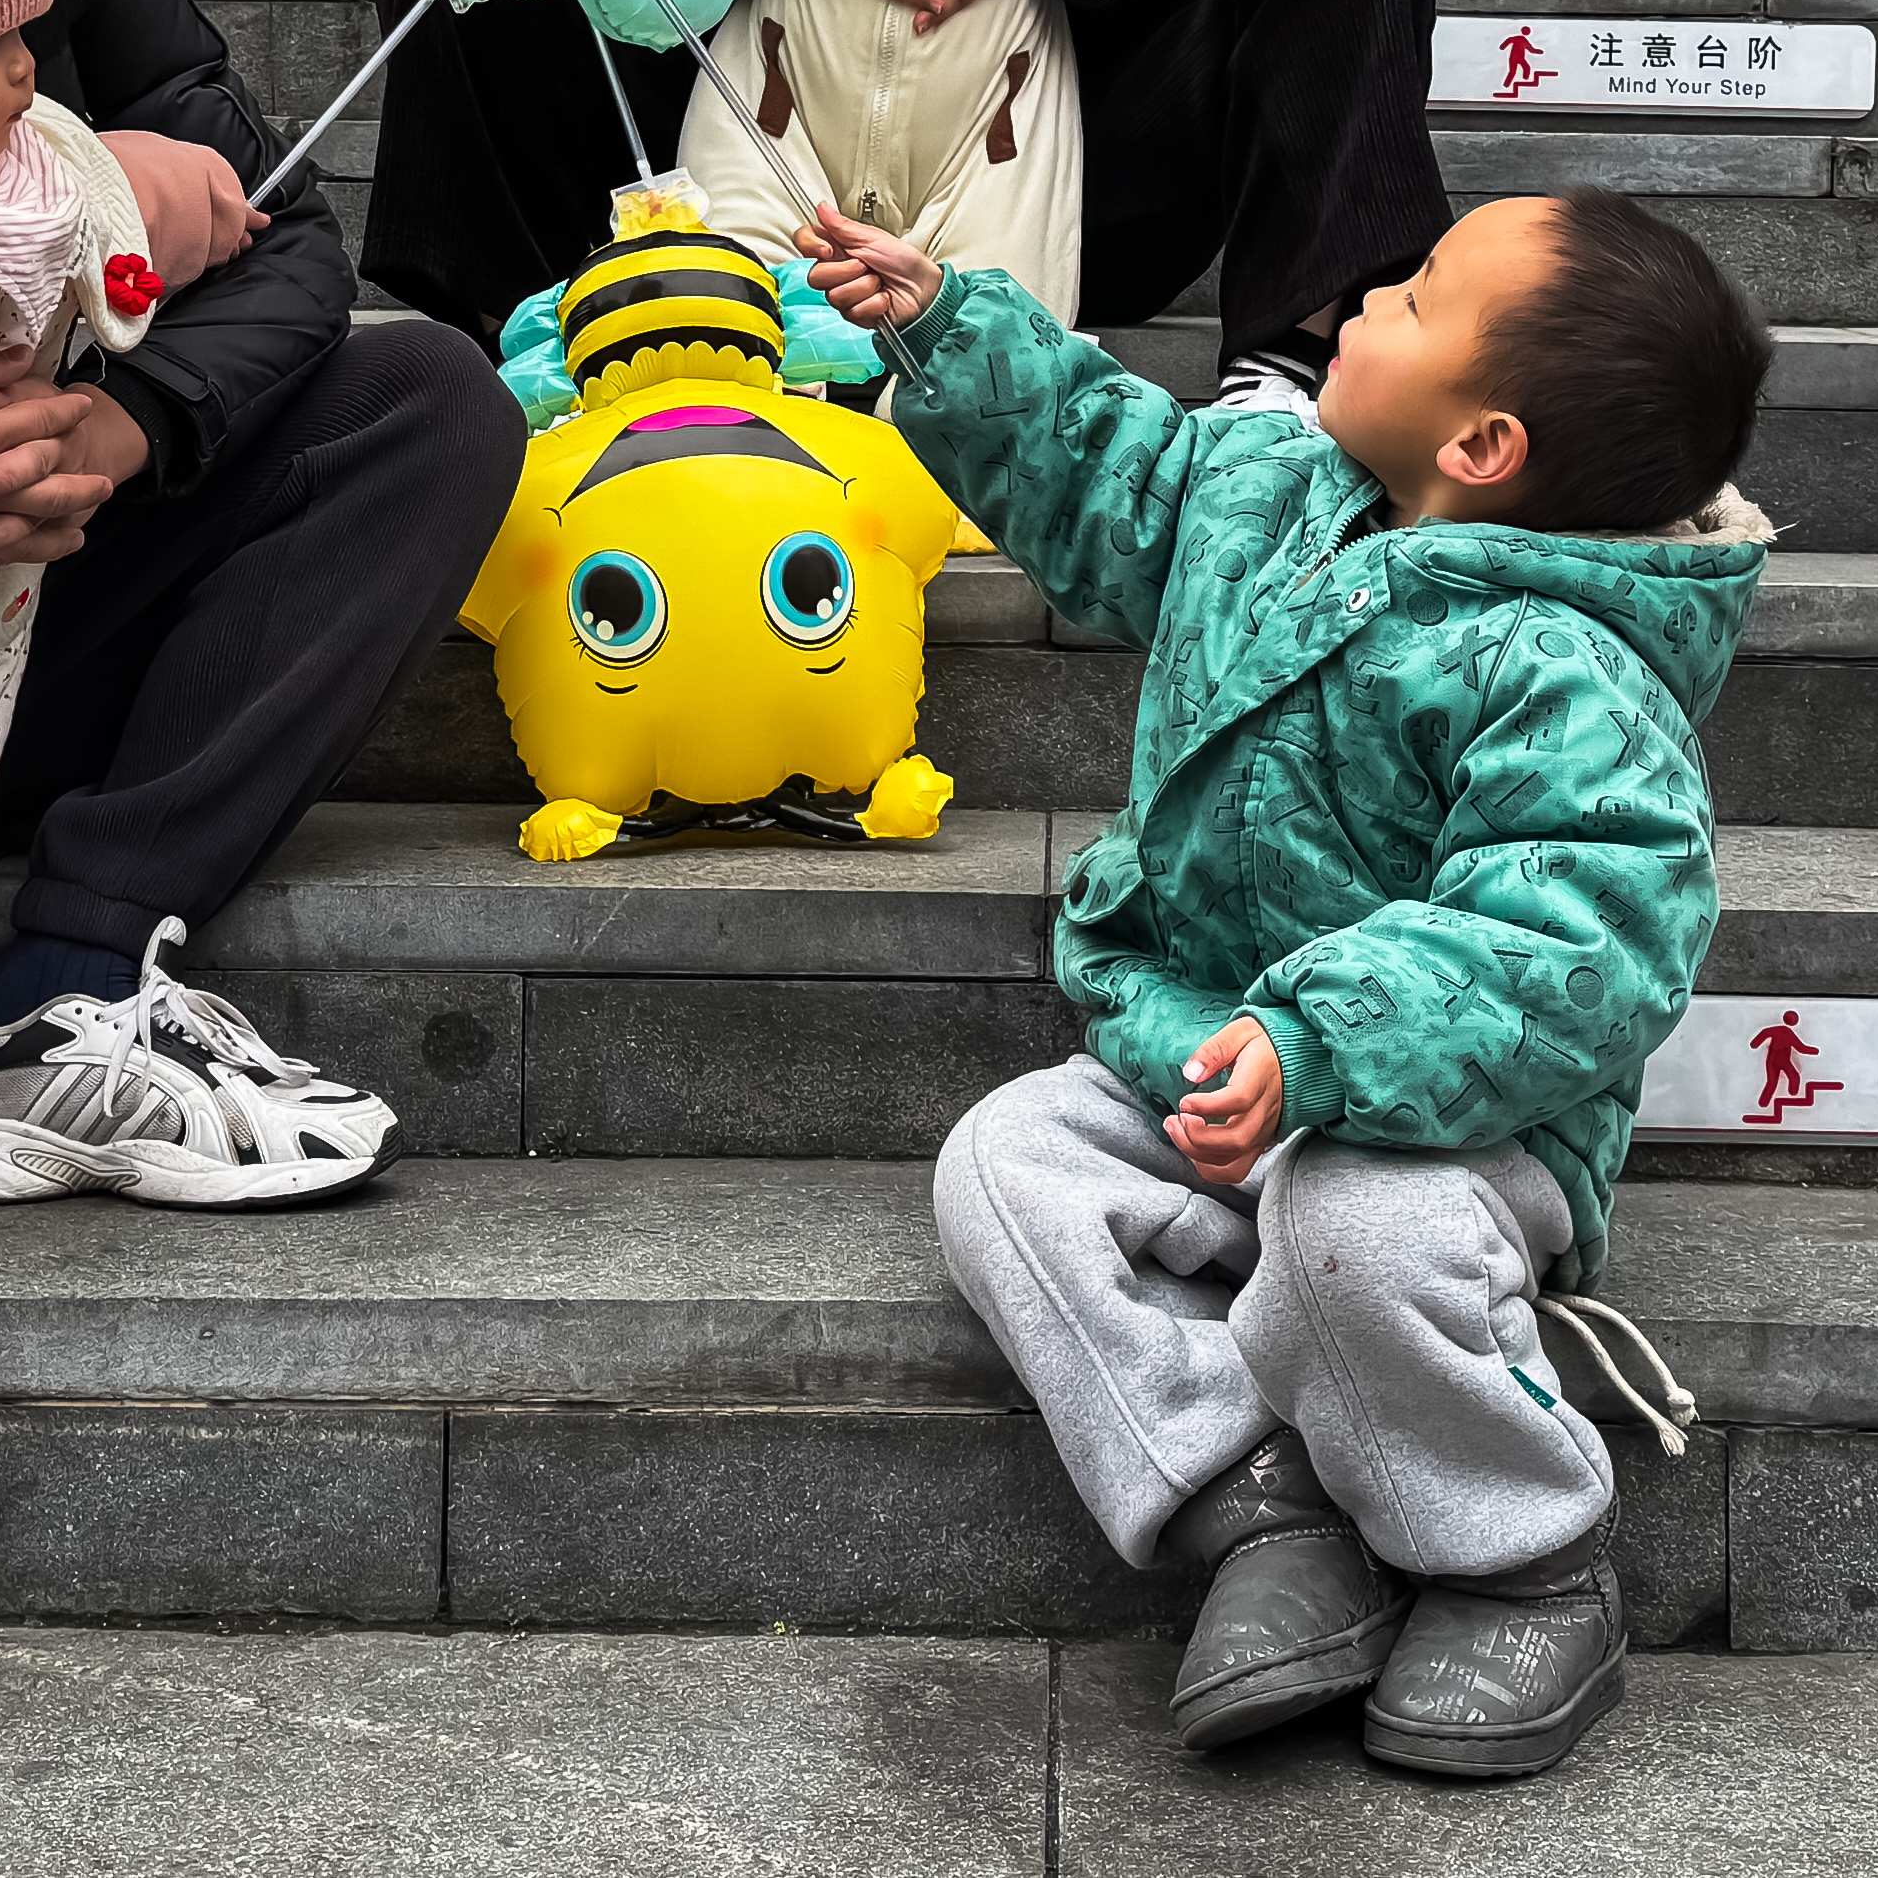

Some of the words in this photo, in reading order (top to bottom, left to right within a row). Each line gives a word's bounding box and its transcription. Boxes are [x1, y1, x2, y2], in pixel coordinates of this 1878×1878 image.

[1588, 33, 1783, 71] 注意台阶
[1608, 76, 1657, 95] Mind
[1665, 78, 1713, 96] Your
[1720, 79, 1767, 99] Step
